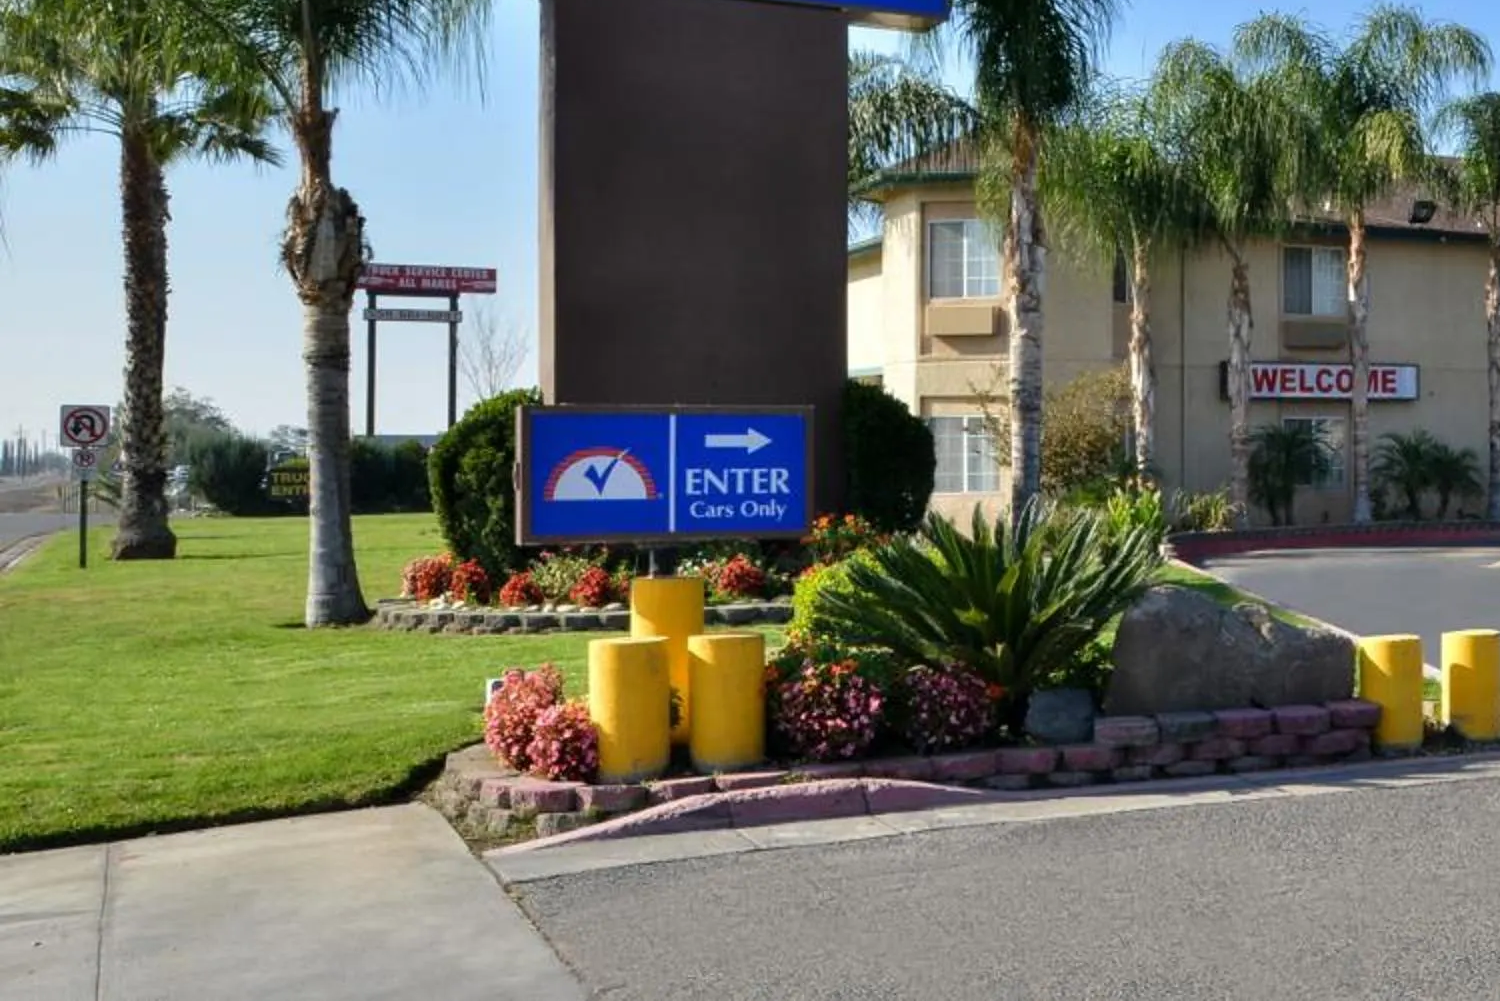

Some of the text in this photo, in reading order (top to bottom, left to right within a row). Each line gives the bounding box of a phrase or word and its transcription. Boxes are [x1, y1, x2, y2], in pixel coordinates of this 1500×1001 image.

[685, 468, 790, 496] ENTER
[689, 499, 788, 521] Cars Only
